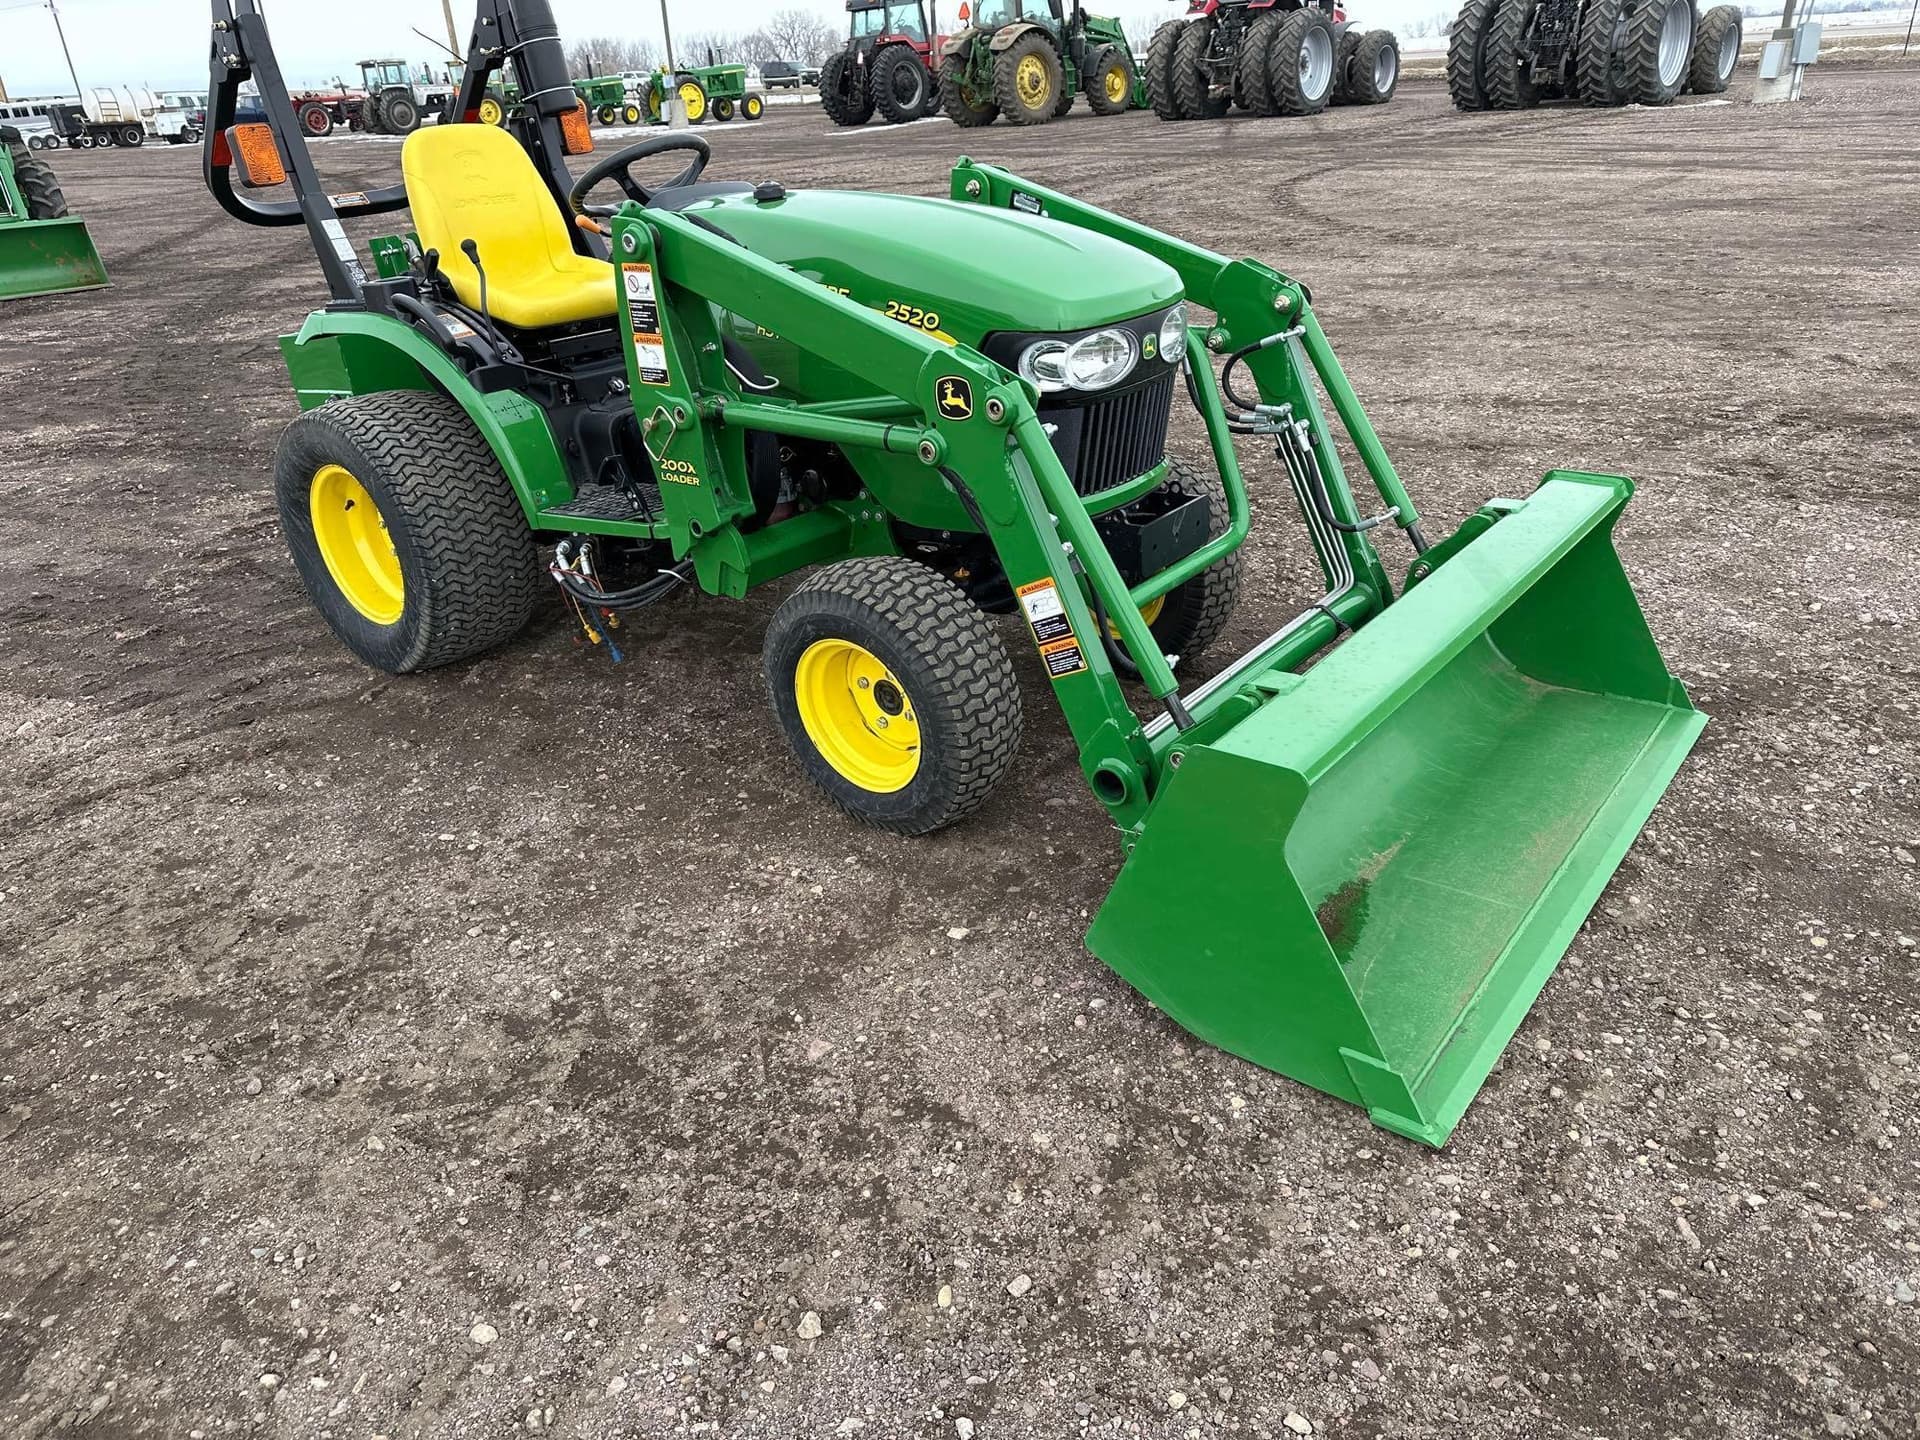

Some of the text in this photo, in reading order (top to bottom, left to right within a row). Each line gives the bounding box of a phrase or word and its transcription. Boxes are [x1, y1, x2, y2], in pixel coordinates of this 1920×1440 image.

[885, 300, 940, 329] 2520
[661, 458, 697, 474] 200X
[661, 471, 700, 487] LOADER
[1027, 581, 1050, 592] WARNING
[1051, 641, 1074, 652] WARNING
